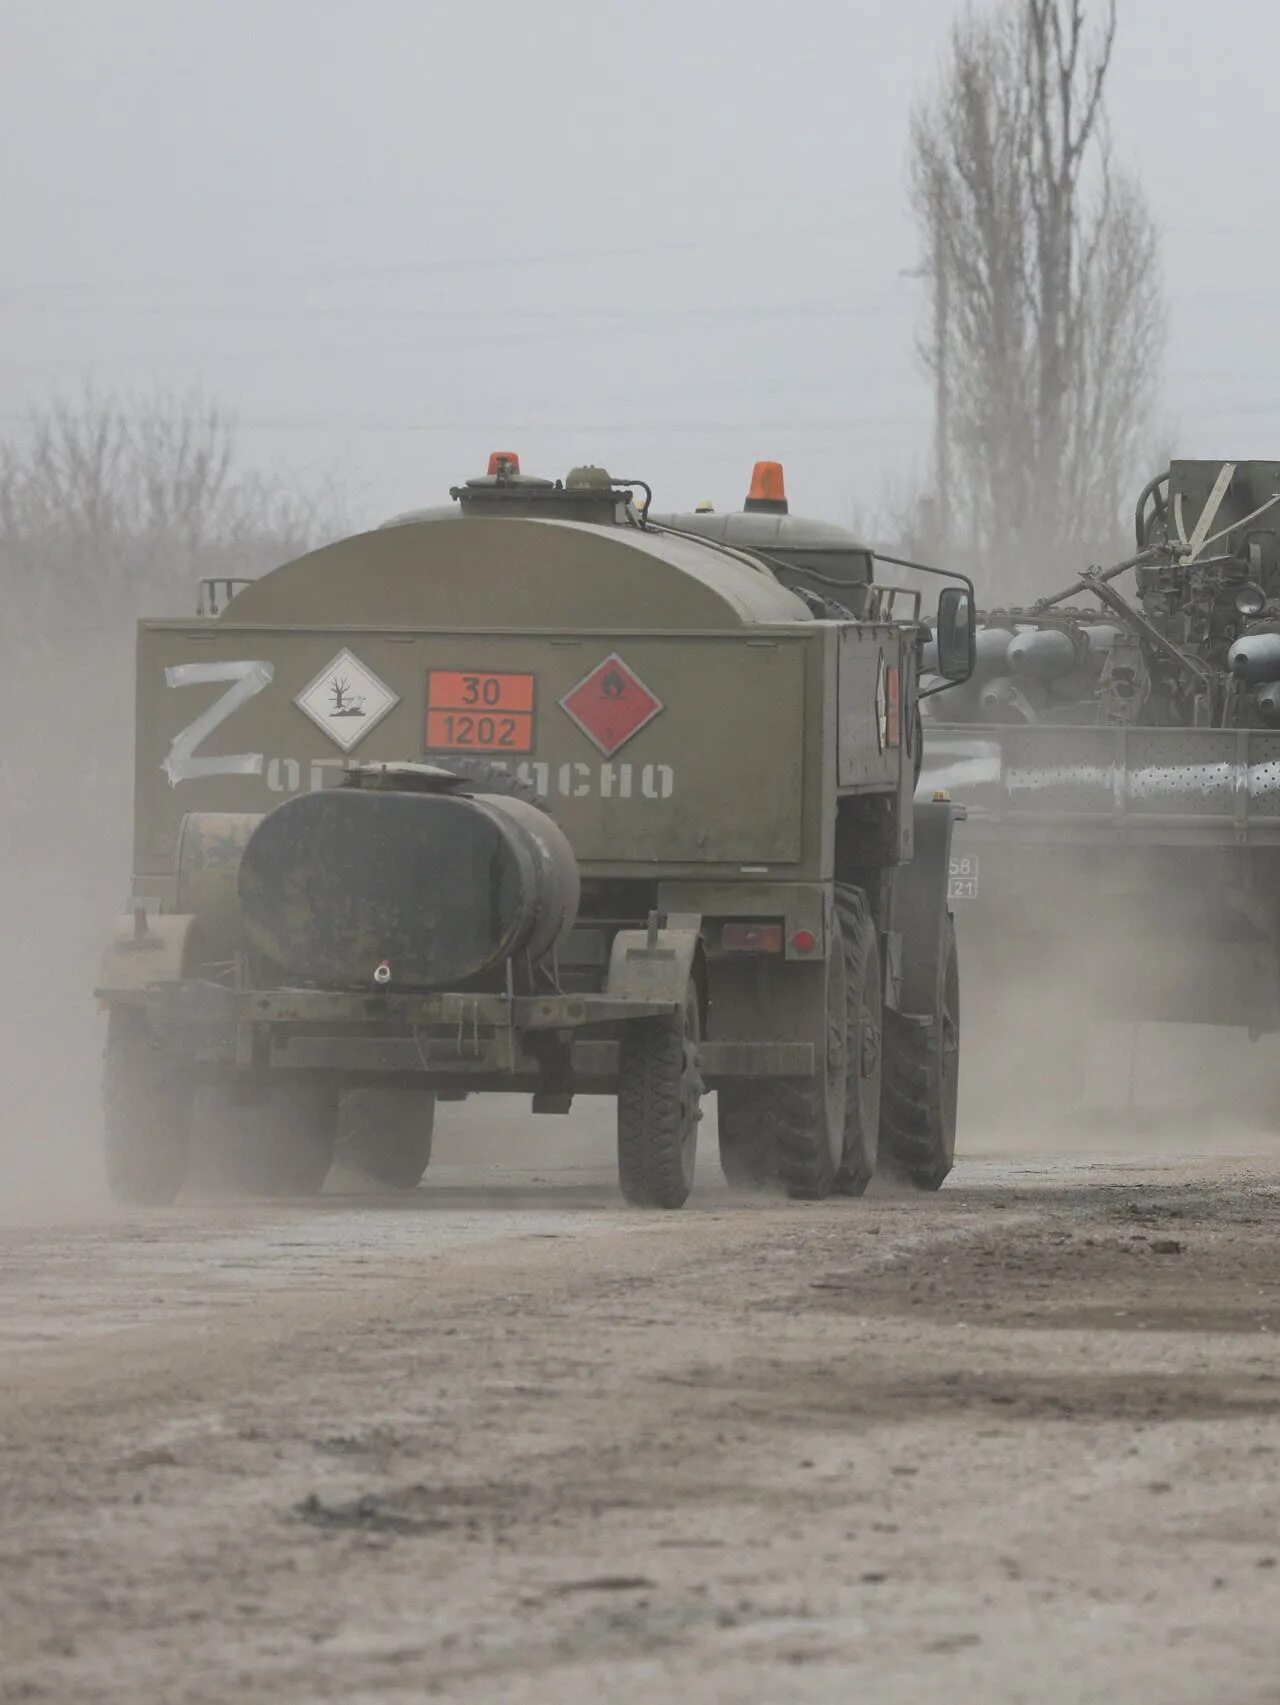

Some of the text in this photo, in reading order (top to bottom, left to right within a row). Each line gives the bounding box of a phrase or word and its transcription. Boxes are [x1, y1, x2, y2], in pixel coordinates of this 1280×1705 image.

[462, 676, 501, 705] 30
[161, 660, 274, 789] Z
[443, 716, 516, 746] 1202
[267, 757, 675, 799] ОГАСНО
[954, 881, 972, 896] 21
